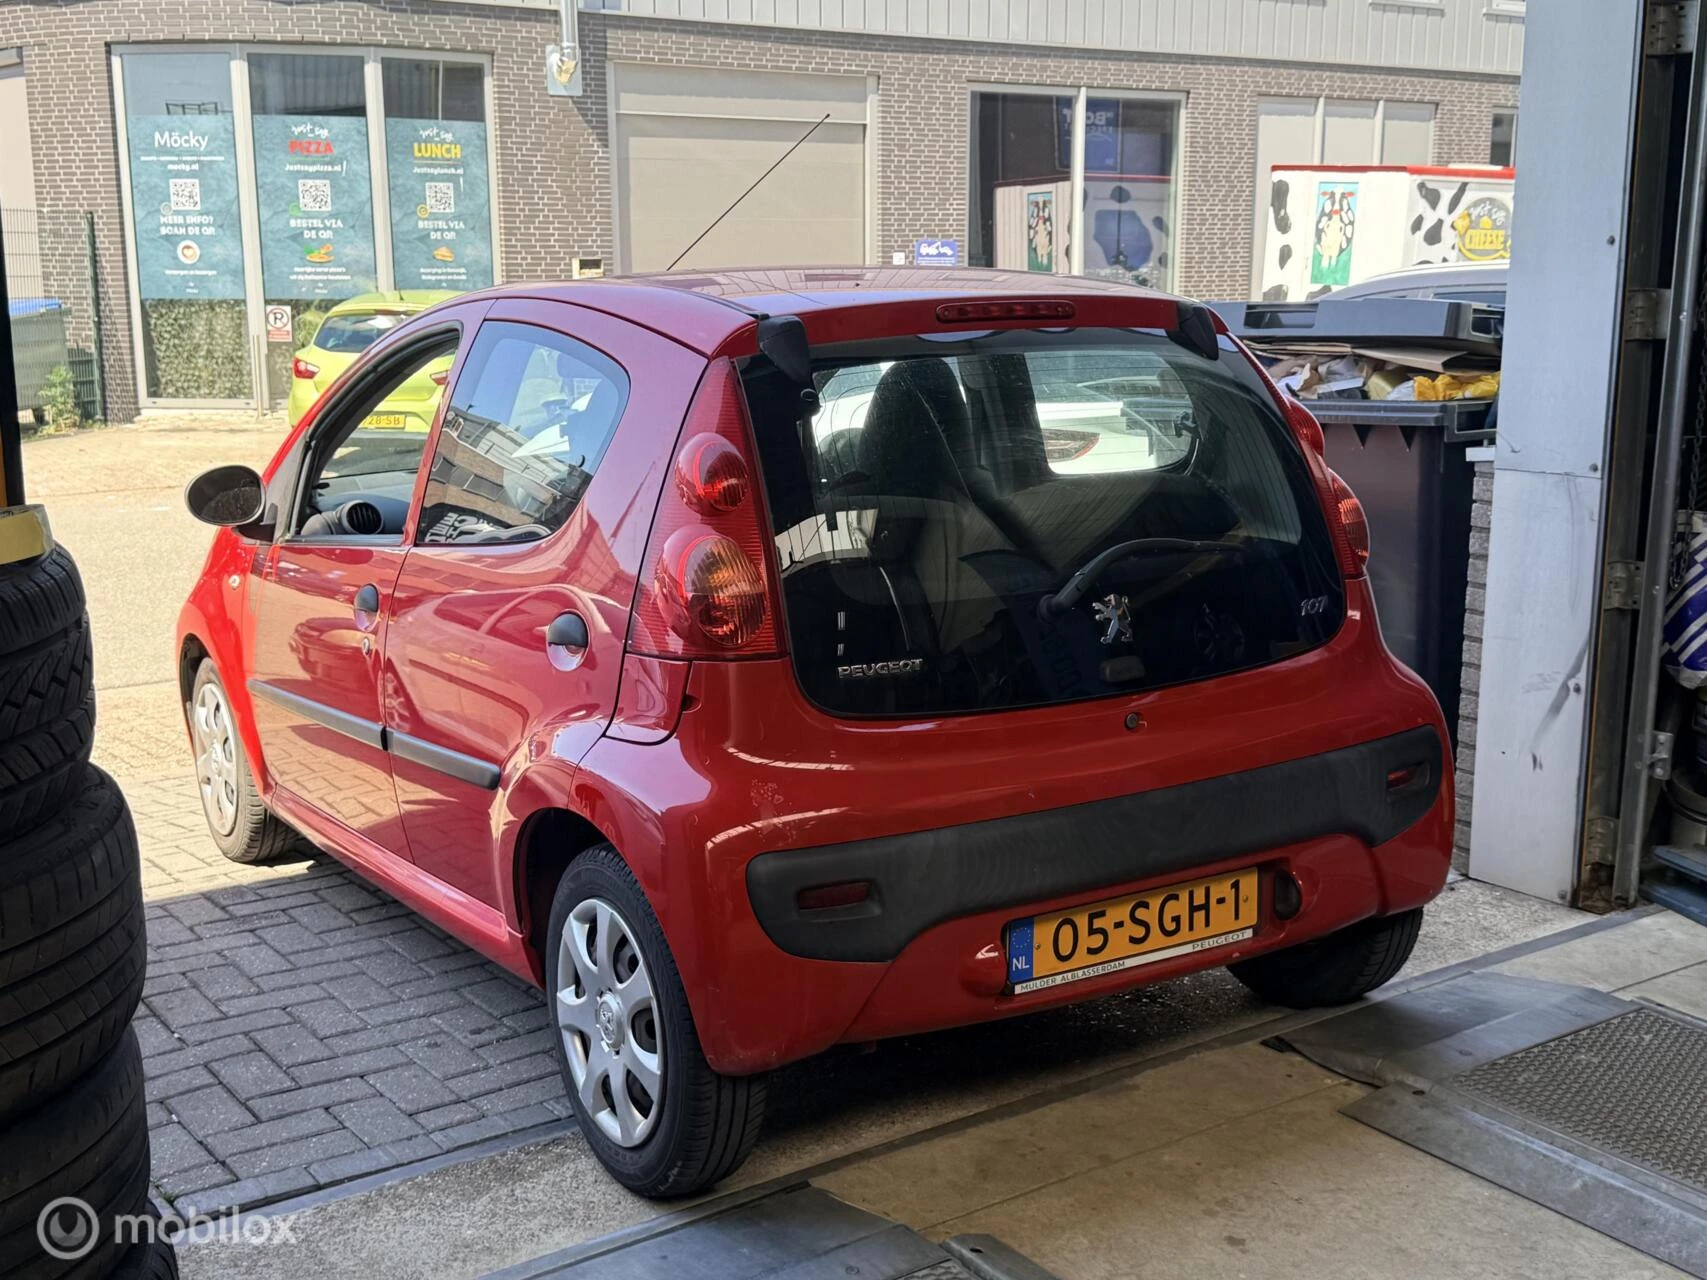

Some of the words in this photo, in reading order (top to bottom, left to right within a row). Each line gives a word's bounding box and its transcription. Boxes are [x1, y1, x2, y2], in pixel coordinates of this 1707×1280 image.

[154, 131, 208, 150] Möcky
[289, 139, 334, 155] PIZZA
[413, 142, 461, 159] LUNCH
[289, 218, 324, 228] BESTEL
[324, 218, 343, 229] VIA
[418, 219, 448, 229] BESTEL
[448, 219, 465, 229] VIA
[303, 229, 317, 239] DE
[318, 229, 334, 239] QR
[430, 231, 442, 240] DE
[443, 231, 457, 240] QR
[1301, 595, 1328, 616] 107
[837, 658, 923, 679] PEUGEOT
[1052, 879, 1241, 963] 05-SGH-1
[1012, 955, 1030, 971] NL
[1020, 976, 1057, 992] MULDER
[1060, 960, 1126, 983] ALBLASSERDAM
[1191, 931, 1248, 951] PEUGEOT
